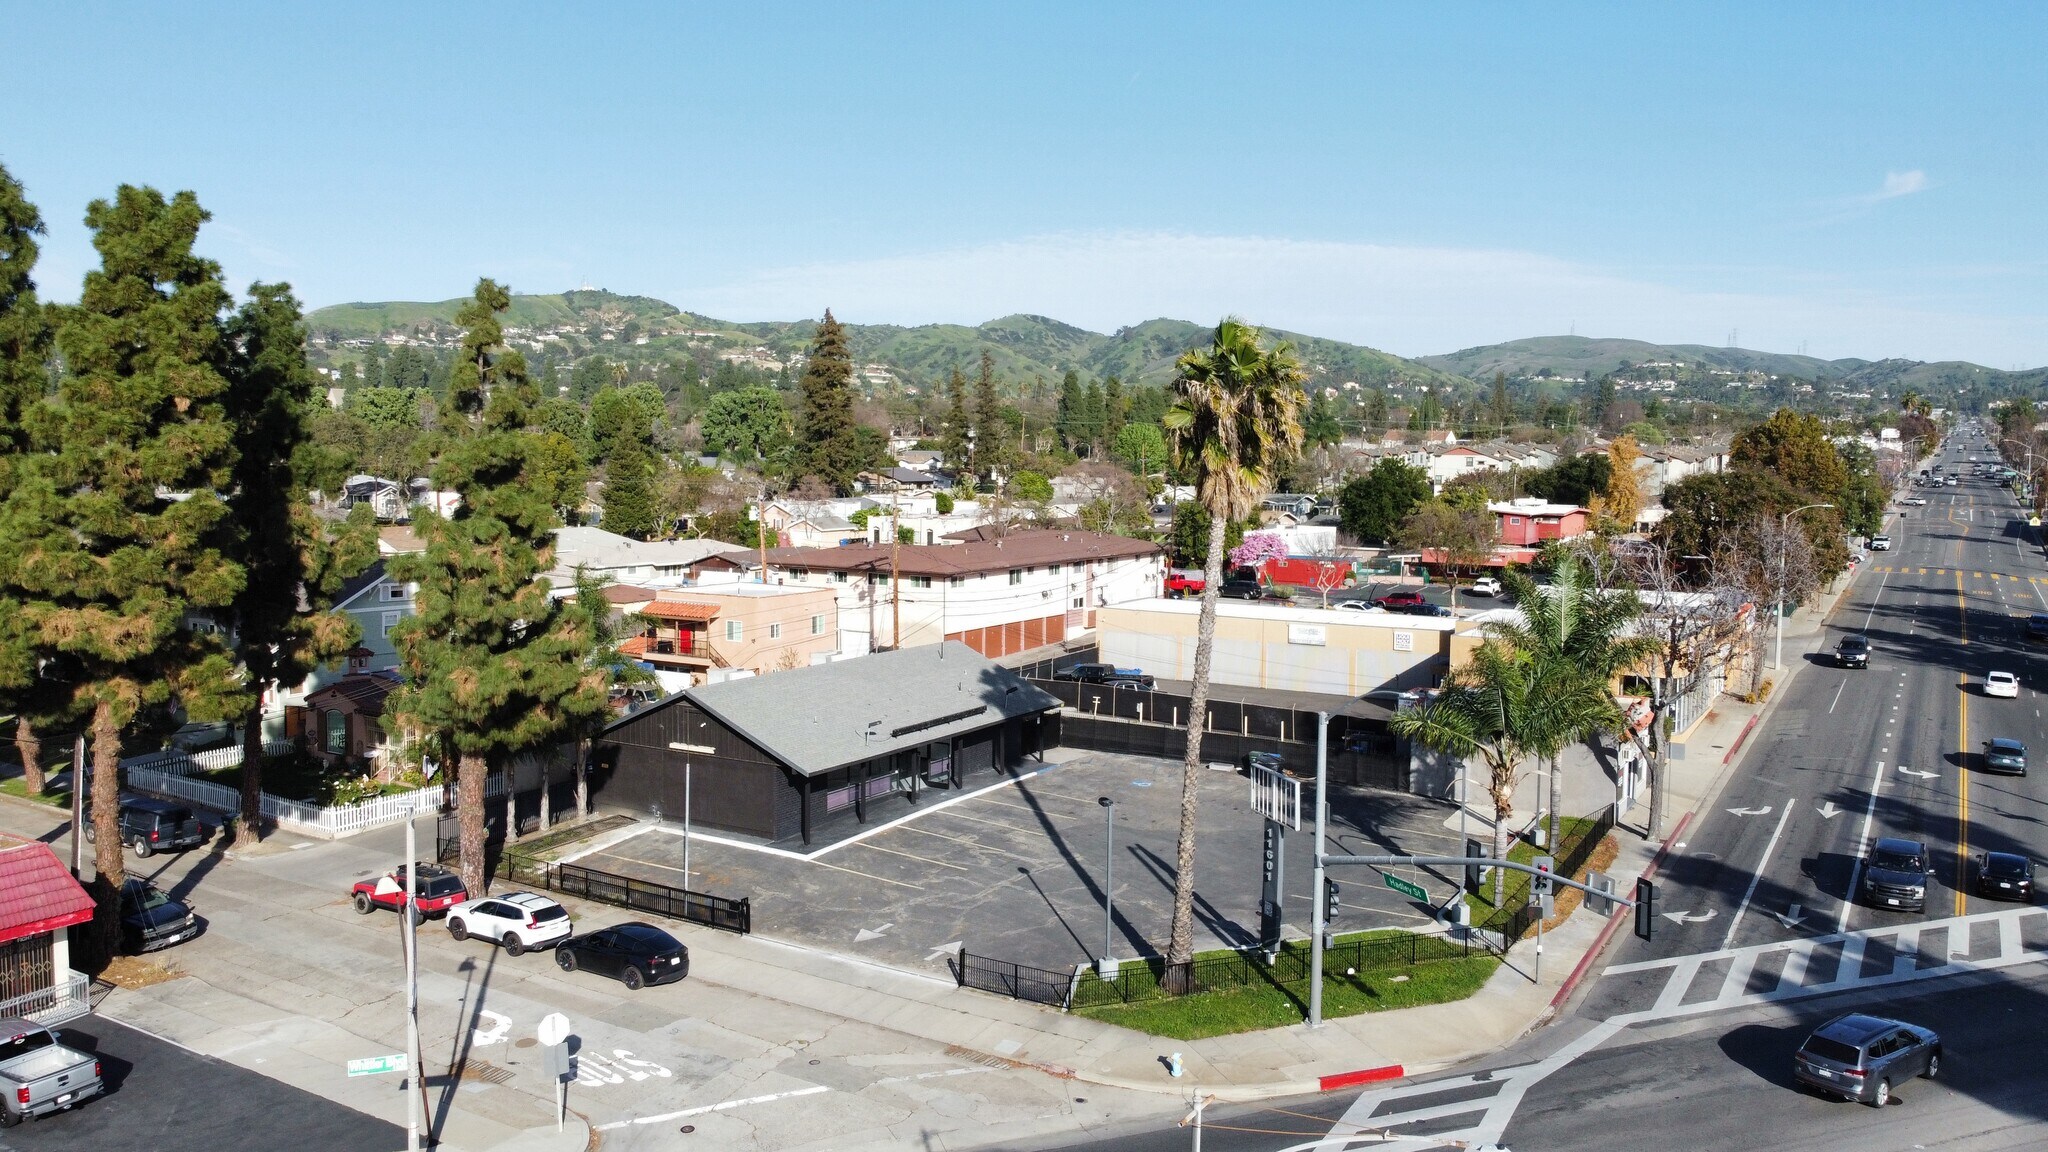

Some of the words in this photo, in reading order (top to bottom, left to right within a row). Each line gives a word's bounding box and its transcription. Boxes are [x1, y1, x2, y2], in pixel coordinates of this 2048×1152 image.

[1979, 634, 2007, 642] SLOW
[1389, 878, 1412, 894] Hadley
[1413, 888, 1421, 898] St
